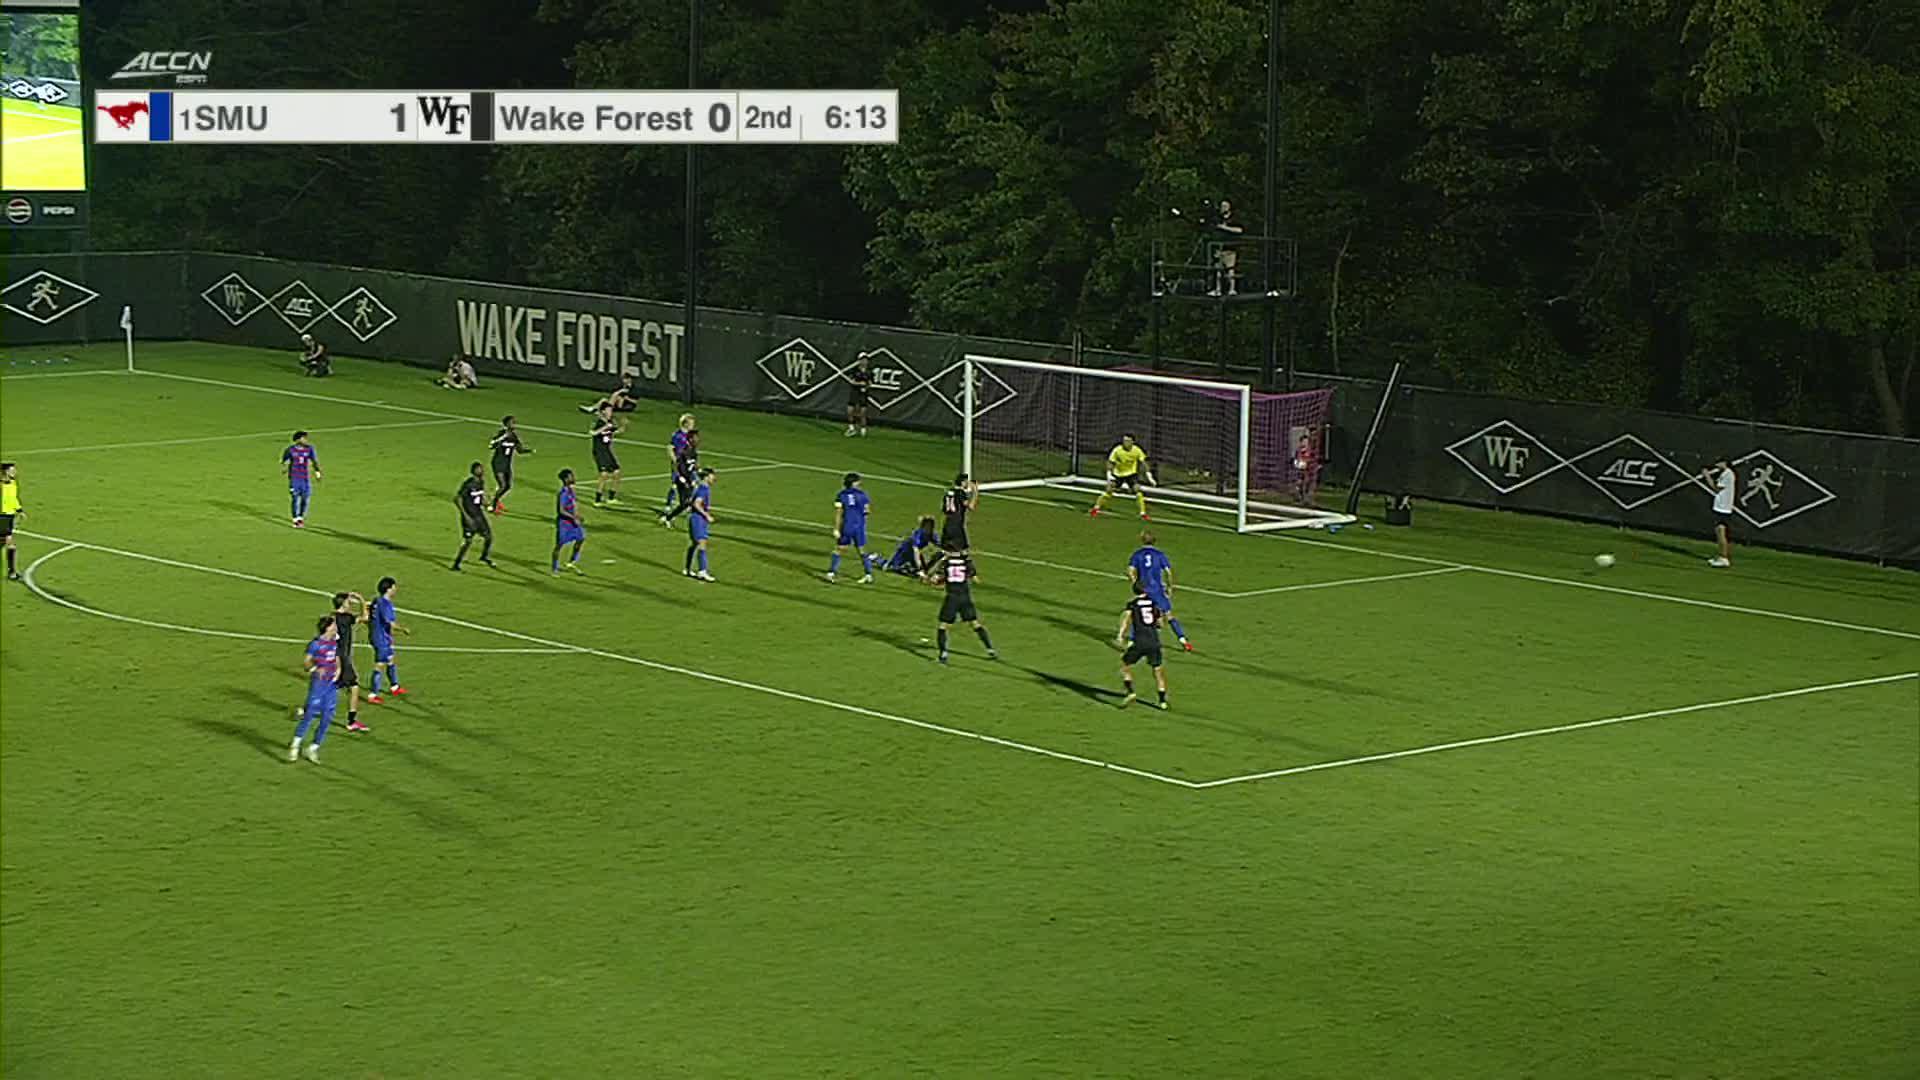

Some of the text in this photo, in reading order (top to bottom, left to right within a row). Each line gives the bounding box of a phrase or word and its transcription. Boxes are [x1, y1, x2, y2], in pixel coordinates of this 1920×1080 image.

[457, 299, 686, 383] WAKE FOREST
[784, 350, 816, 386] WF
[1483, 434, 1529, 478] WF
[1602, 459, 1660, 481] ACC
[1144, 554, 1152, 568] 3
[946, 565, 968, 583] 15
[1140, 606, 1155, 625] 5
